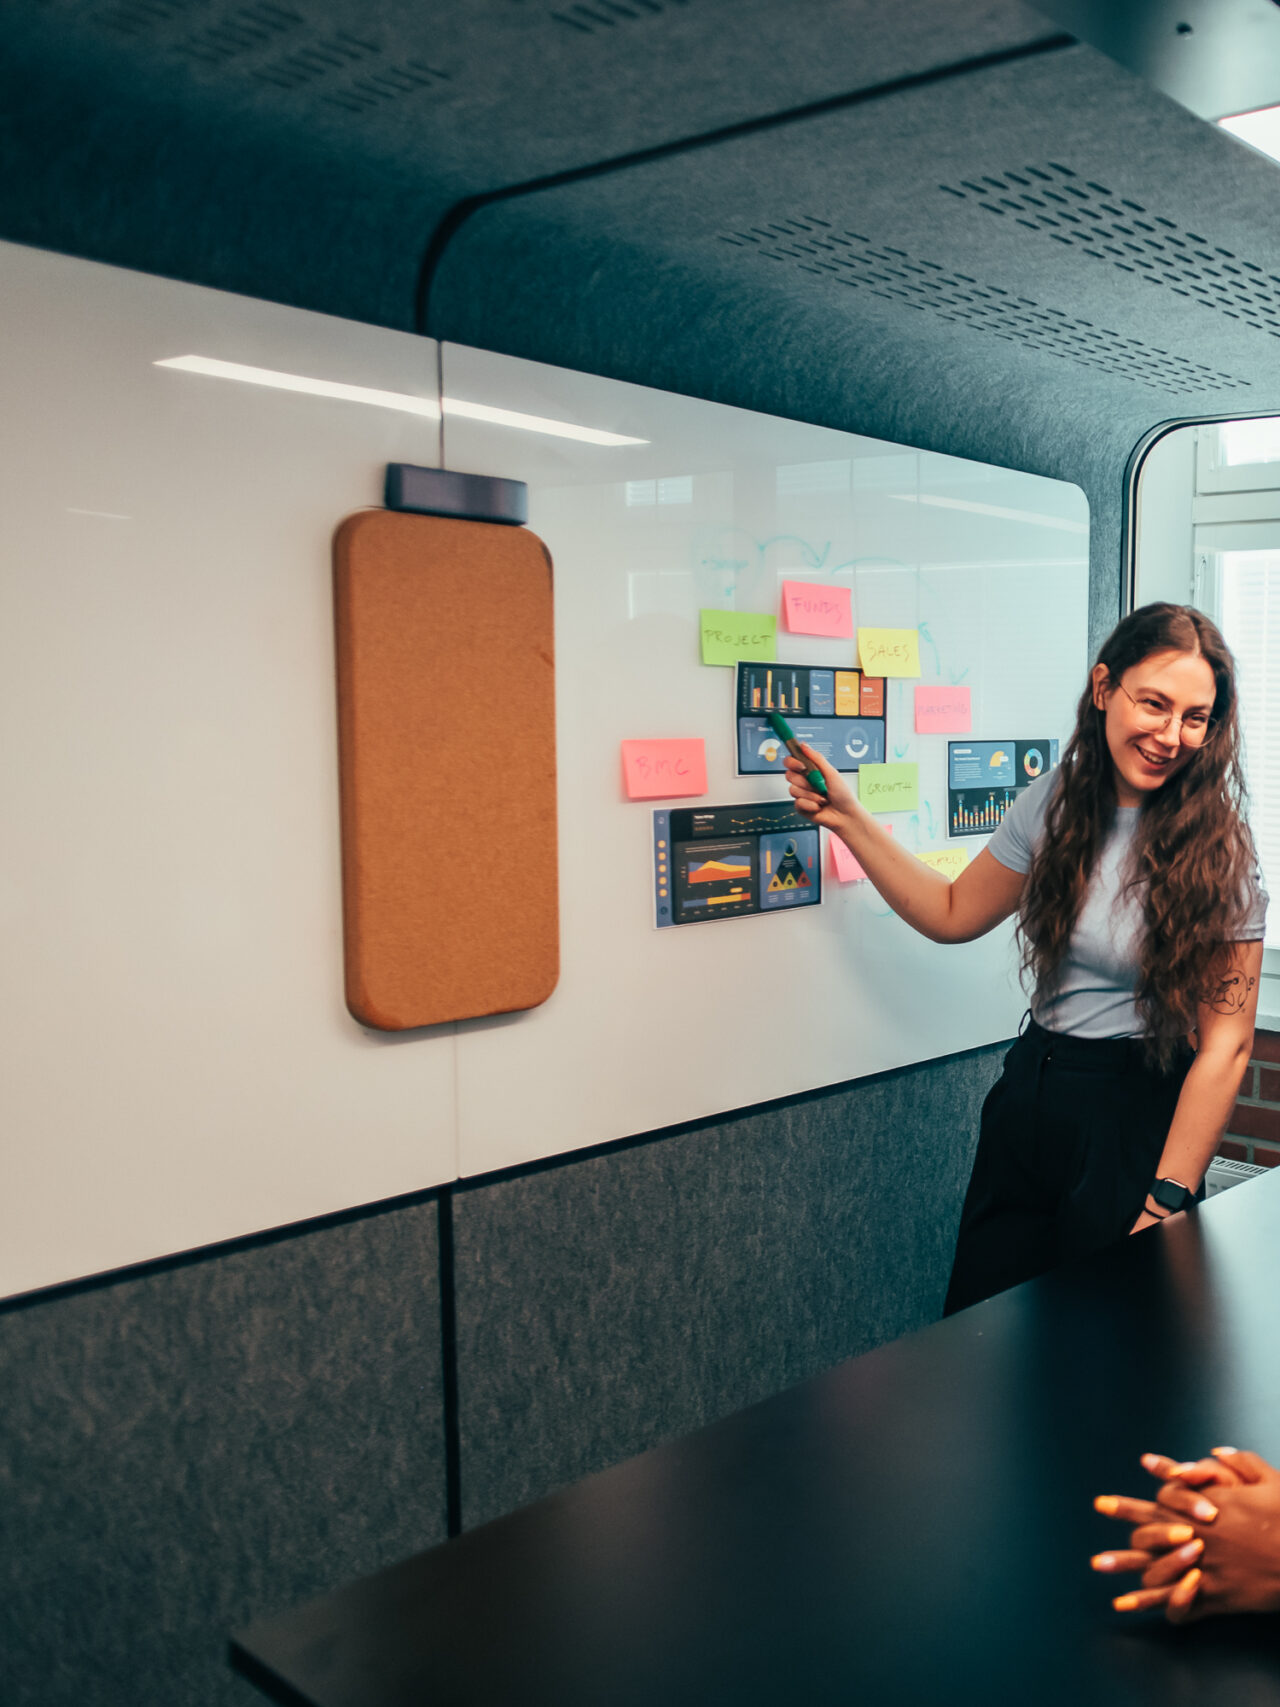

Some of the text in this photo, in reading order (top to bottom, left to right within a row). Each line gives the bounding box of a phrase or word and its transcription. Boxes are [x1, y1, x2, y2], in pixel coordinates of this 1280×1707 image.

[792, 597, 842, 624] FUNDS
[704, 629, 773, 646] PROJECT
[866, 641, 910, 662] SALES
[867, 782, 912, 795] GROWTH
